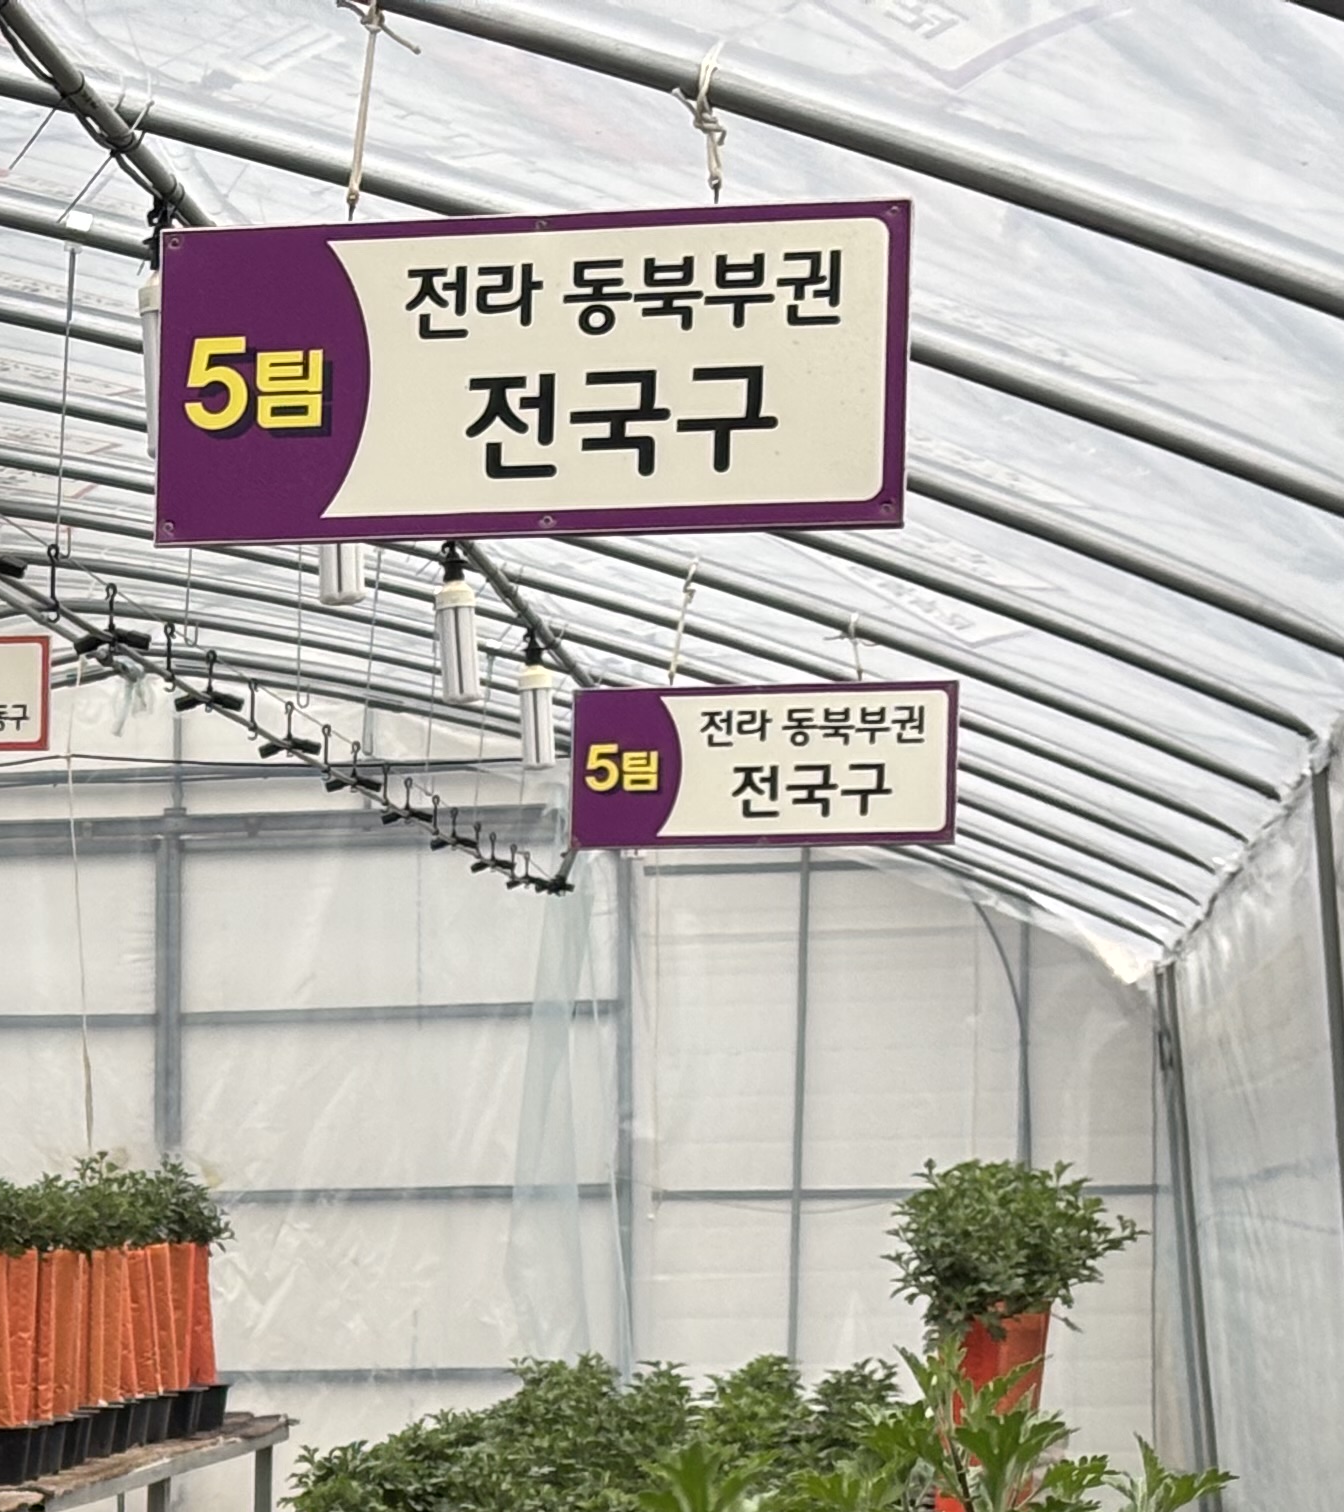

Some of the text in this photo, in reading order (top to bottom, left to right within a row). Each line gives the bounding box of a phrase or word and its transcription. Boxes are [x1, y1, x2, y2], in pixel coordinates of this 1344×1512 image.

[405, 249, 843, 340] 전라 동북부권
[183, 336, 325, 431] 5팀
[465, 363, 779, 480] 전국구
[699, 704, 926, 747] 전라 동북부권
[584, 743, 659, 792] 5팀
[731, 762, 893, 818] 전국구
